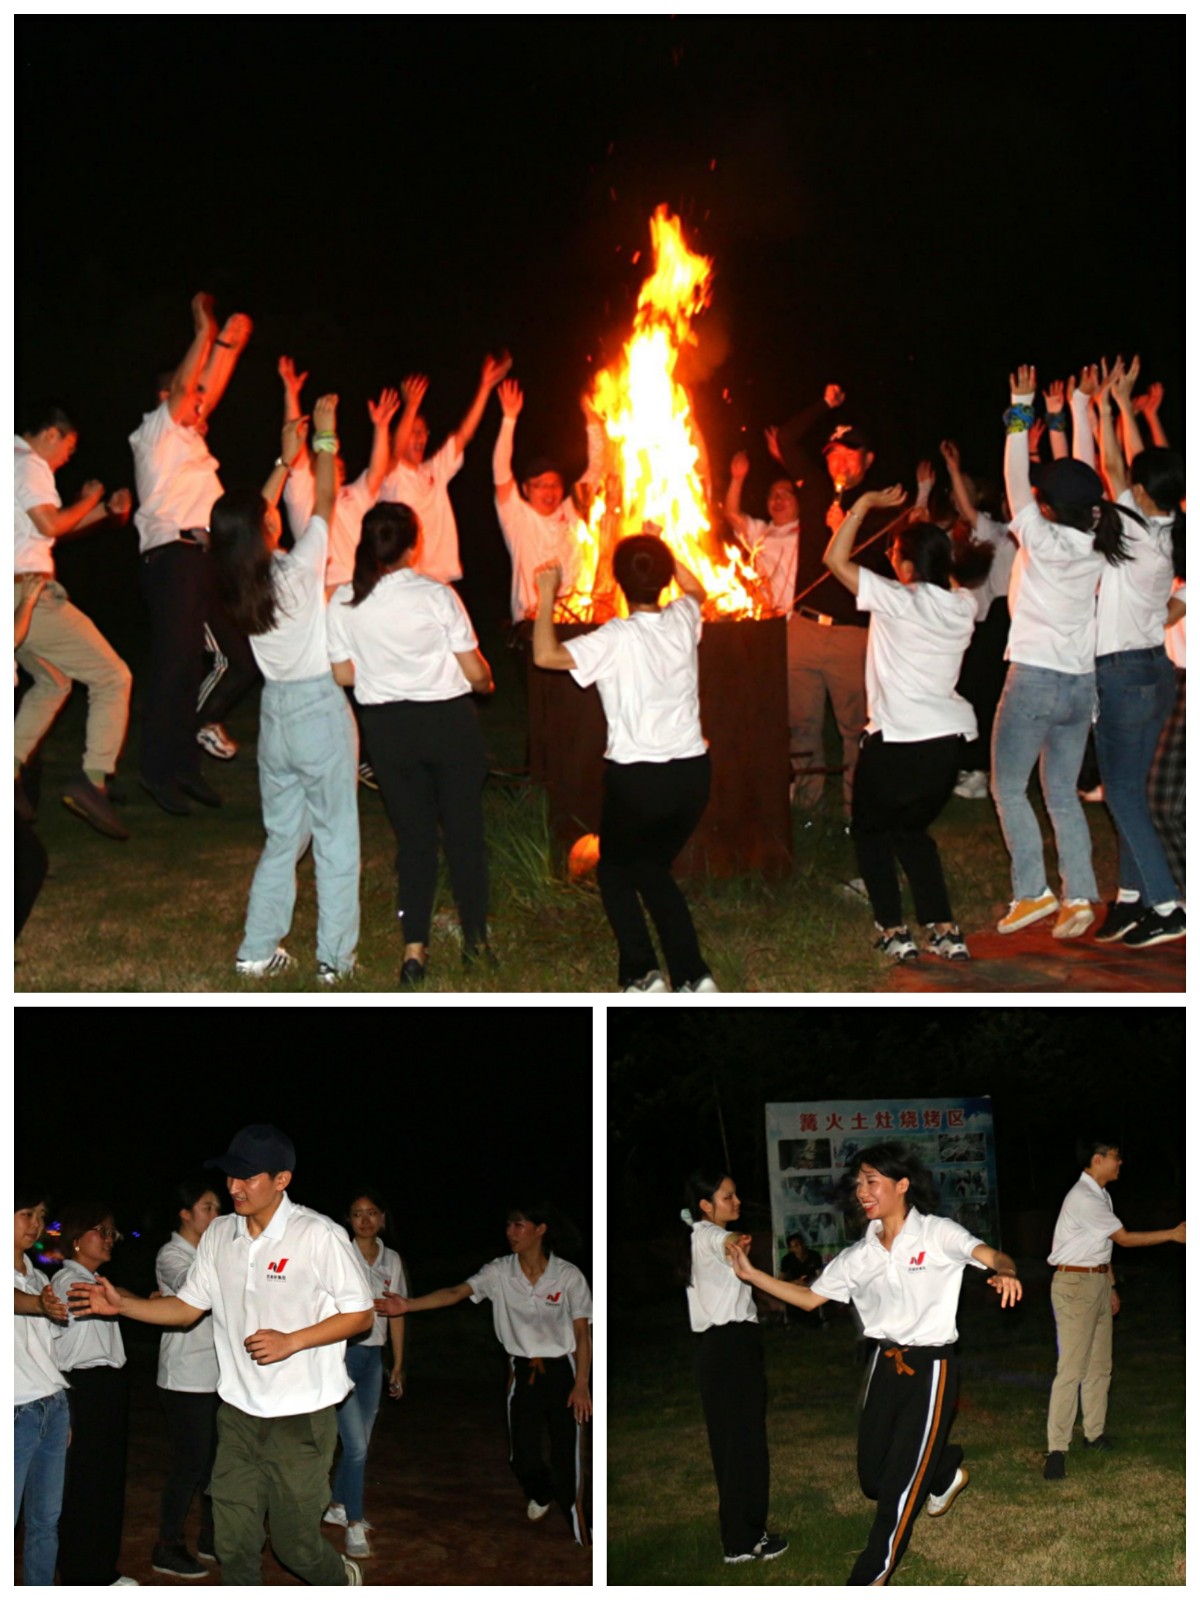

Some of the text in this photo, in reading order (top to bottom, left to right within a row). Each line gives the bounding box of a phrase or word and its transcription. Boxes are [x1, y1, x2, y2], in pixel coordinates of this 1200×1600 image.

[799, 1110, 965, 1131] 篝火土灶烧烤区
